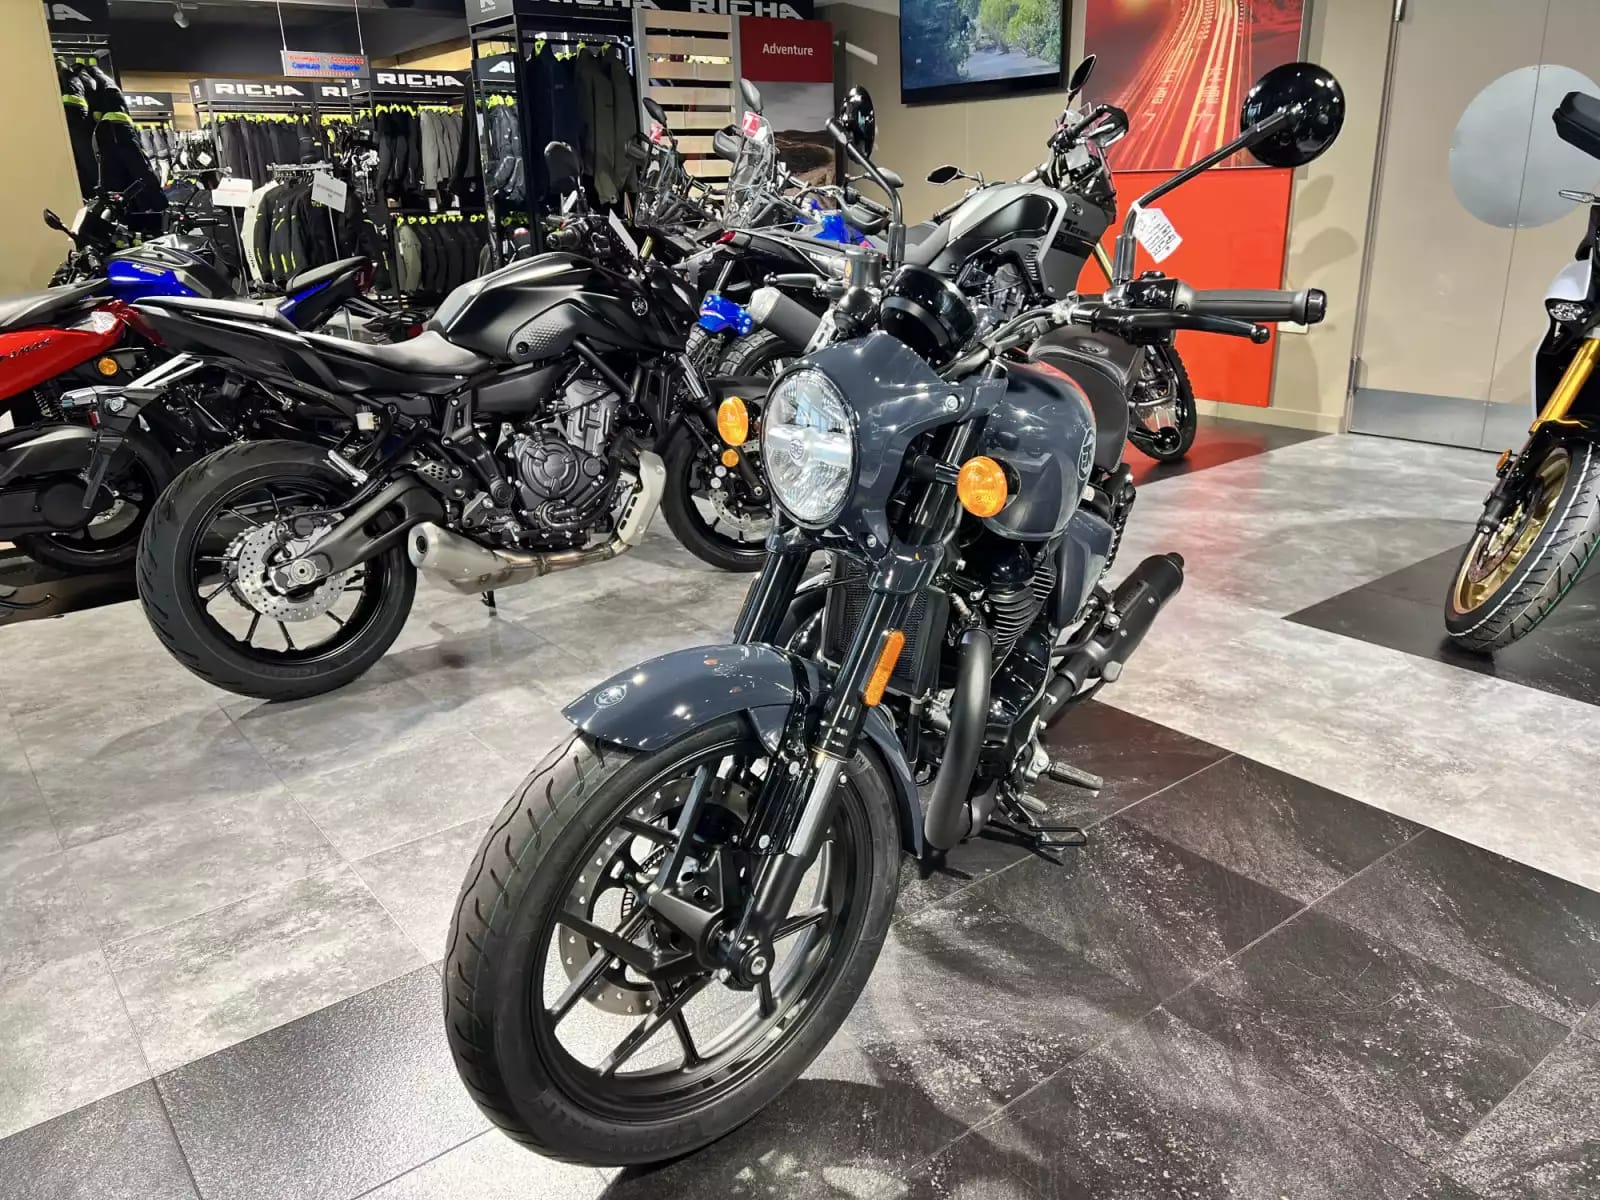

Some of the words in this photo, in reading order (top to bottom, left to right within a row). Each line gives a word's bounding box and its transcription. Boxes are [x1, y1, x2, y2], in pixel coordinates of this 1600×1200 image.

[689, 0, 805, 20] RICHA
[762, 42, 814, 56] Adventure
[377, 73, 464, 87] RICHA
[214, 83, 305, 96] RICHA
